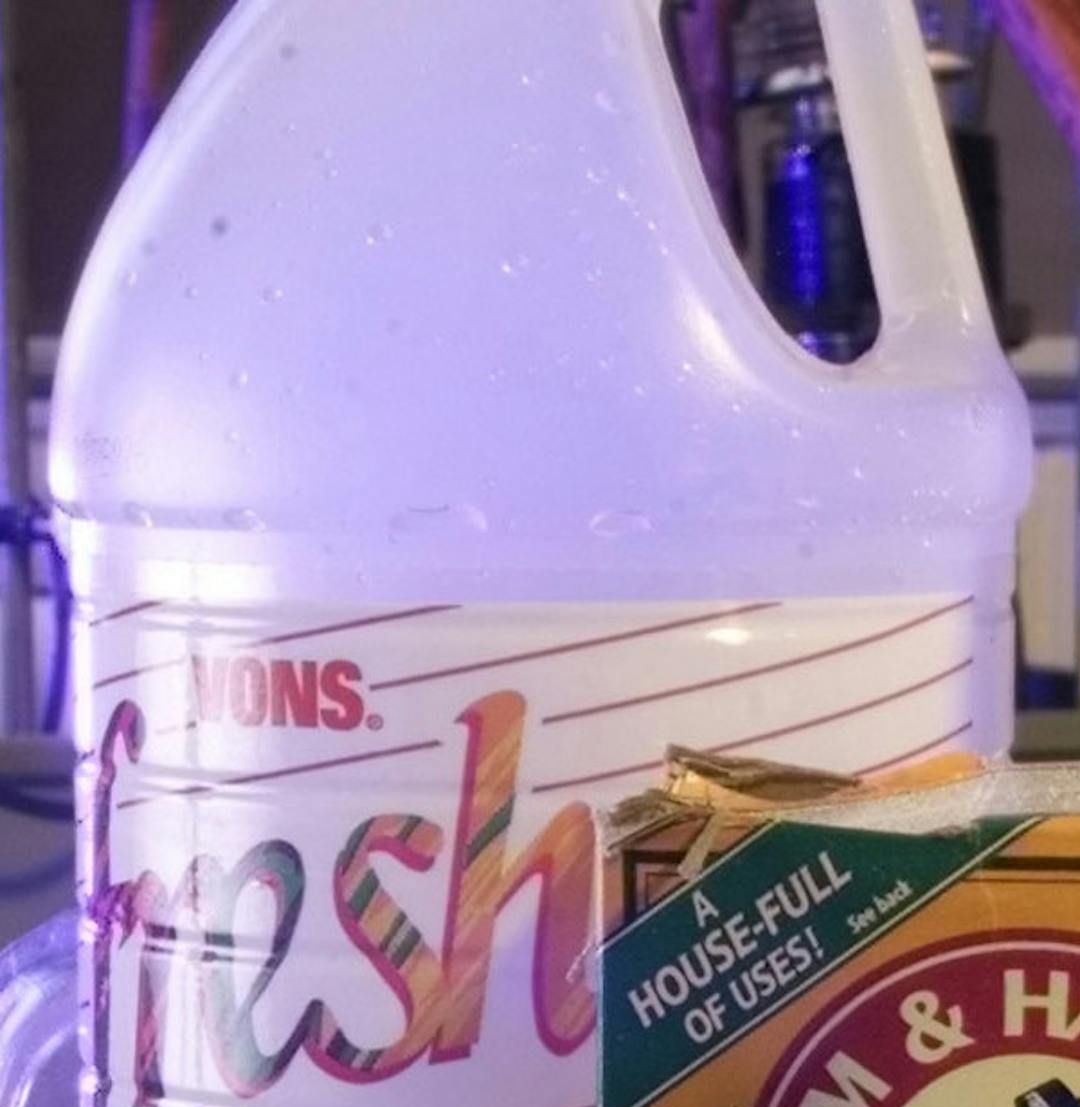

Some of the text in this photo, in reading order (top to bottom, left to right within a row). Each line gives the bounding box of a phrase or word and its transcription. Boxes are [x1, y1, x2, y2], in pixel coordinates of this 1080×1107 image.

[626, 851, 852, 1027] HOUSE-FULL
[693, 889, 719, 929] A
[847, 880, 914, 934] See back
[684, 925, 825, 1044] OF USES!
[899, 989, 976, 1063] &
